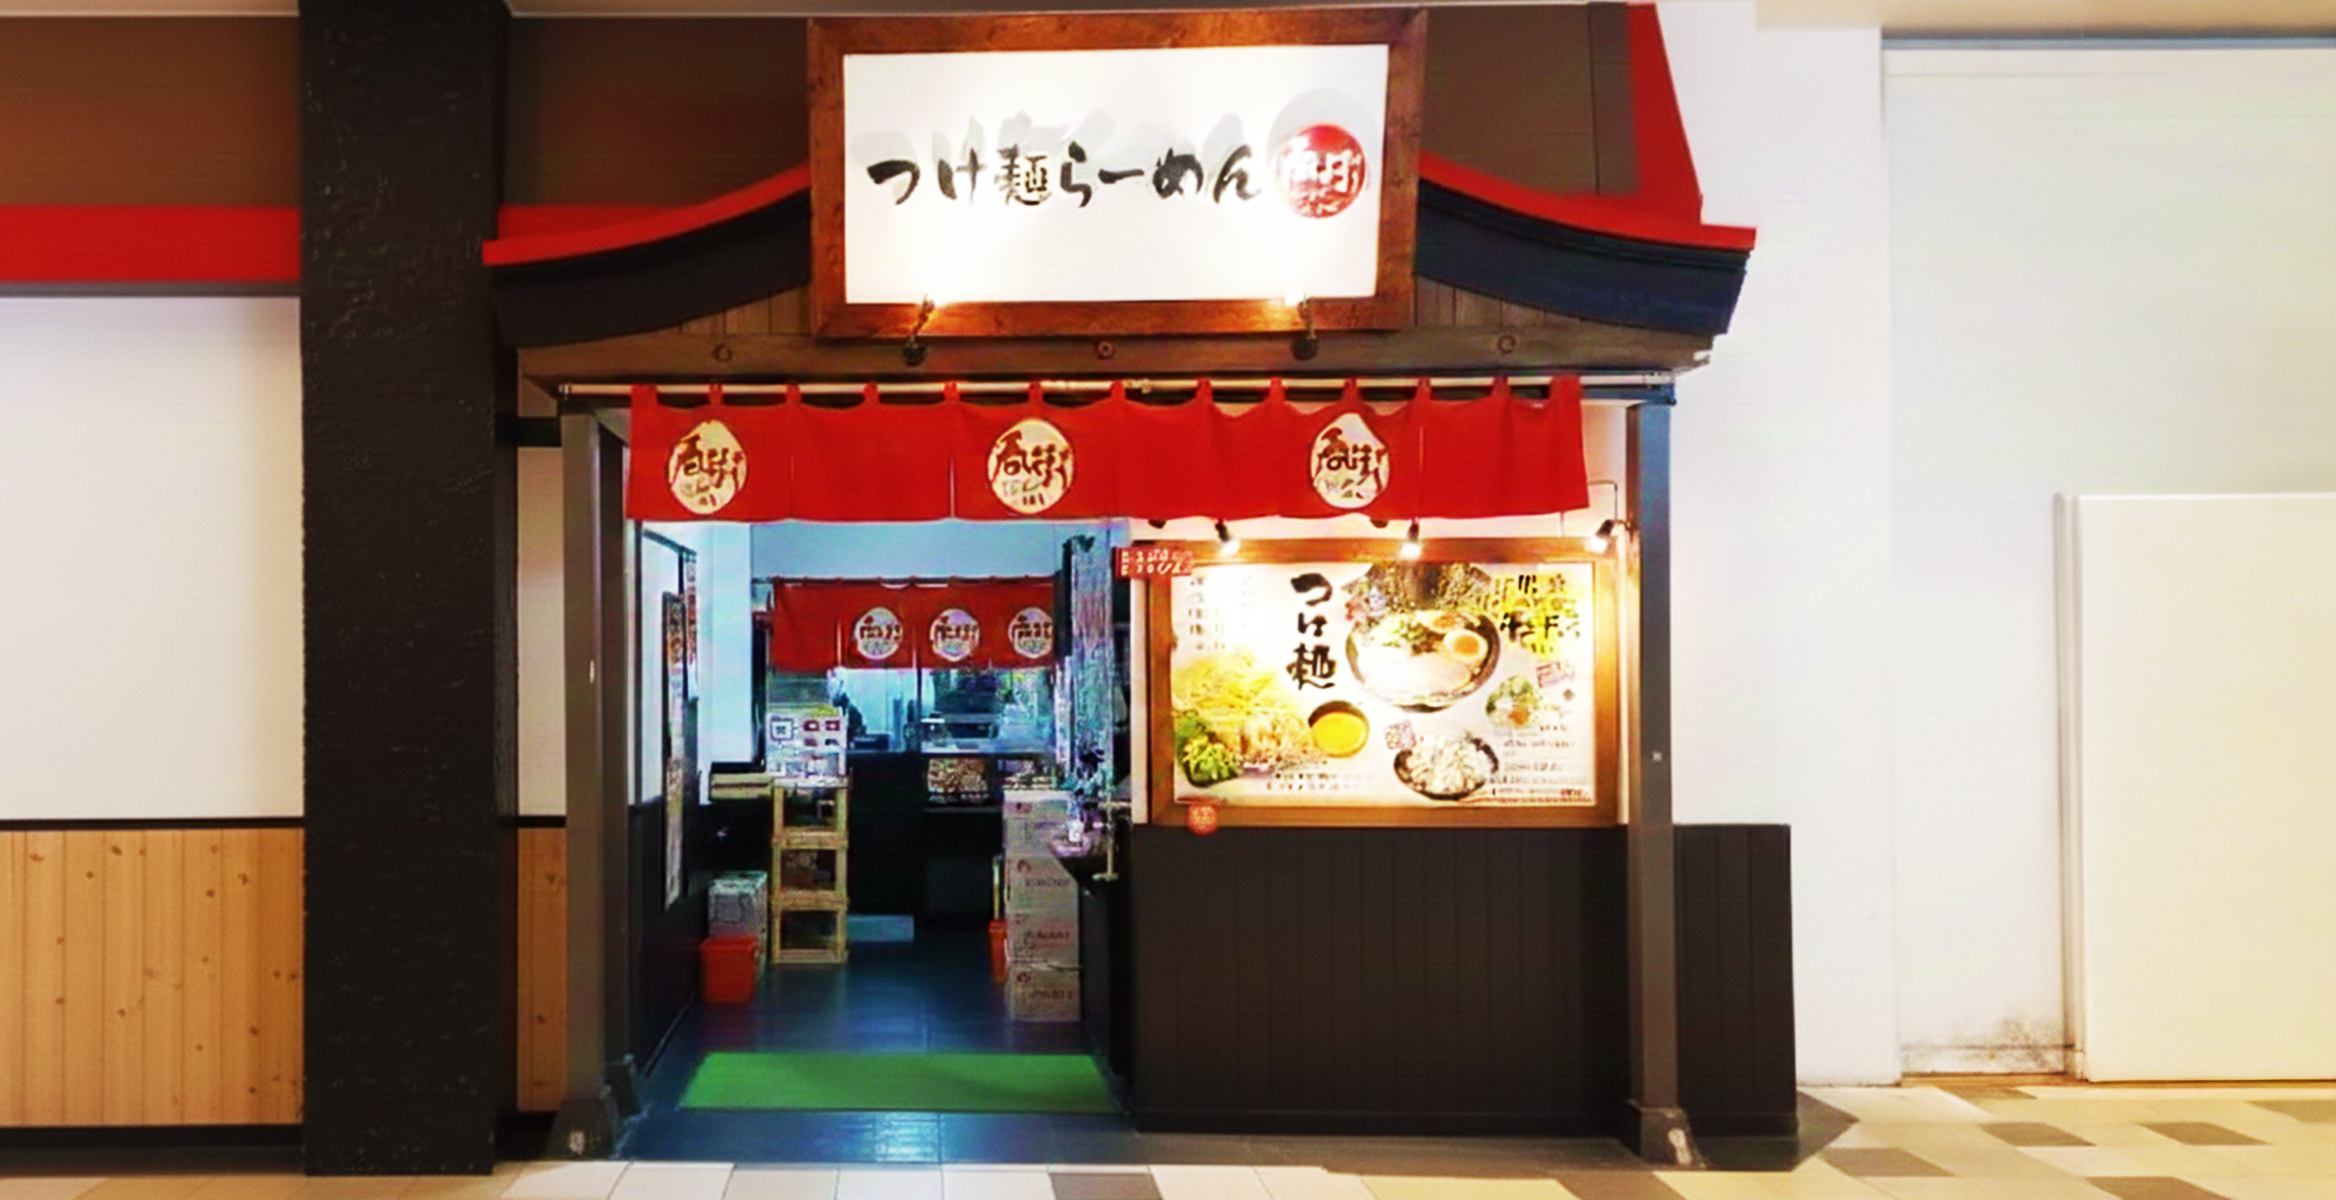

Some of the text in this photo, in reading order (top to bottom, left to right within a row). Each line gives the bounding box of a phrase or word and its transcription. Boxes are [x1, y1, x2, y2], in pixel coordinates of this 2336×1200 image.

[866, 143, 1261, 207] つけ麺らーめん
[1286, 573, 1337, 690] つけ麺
